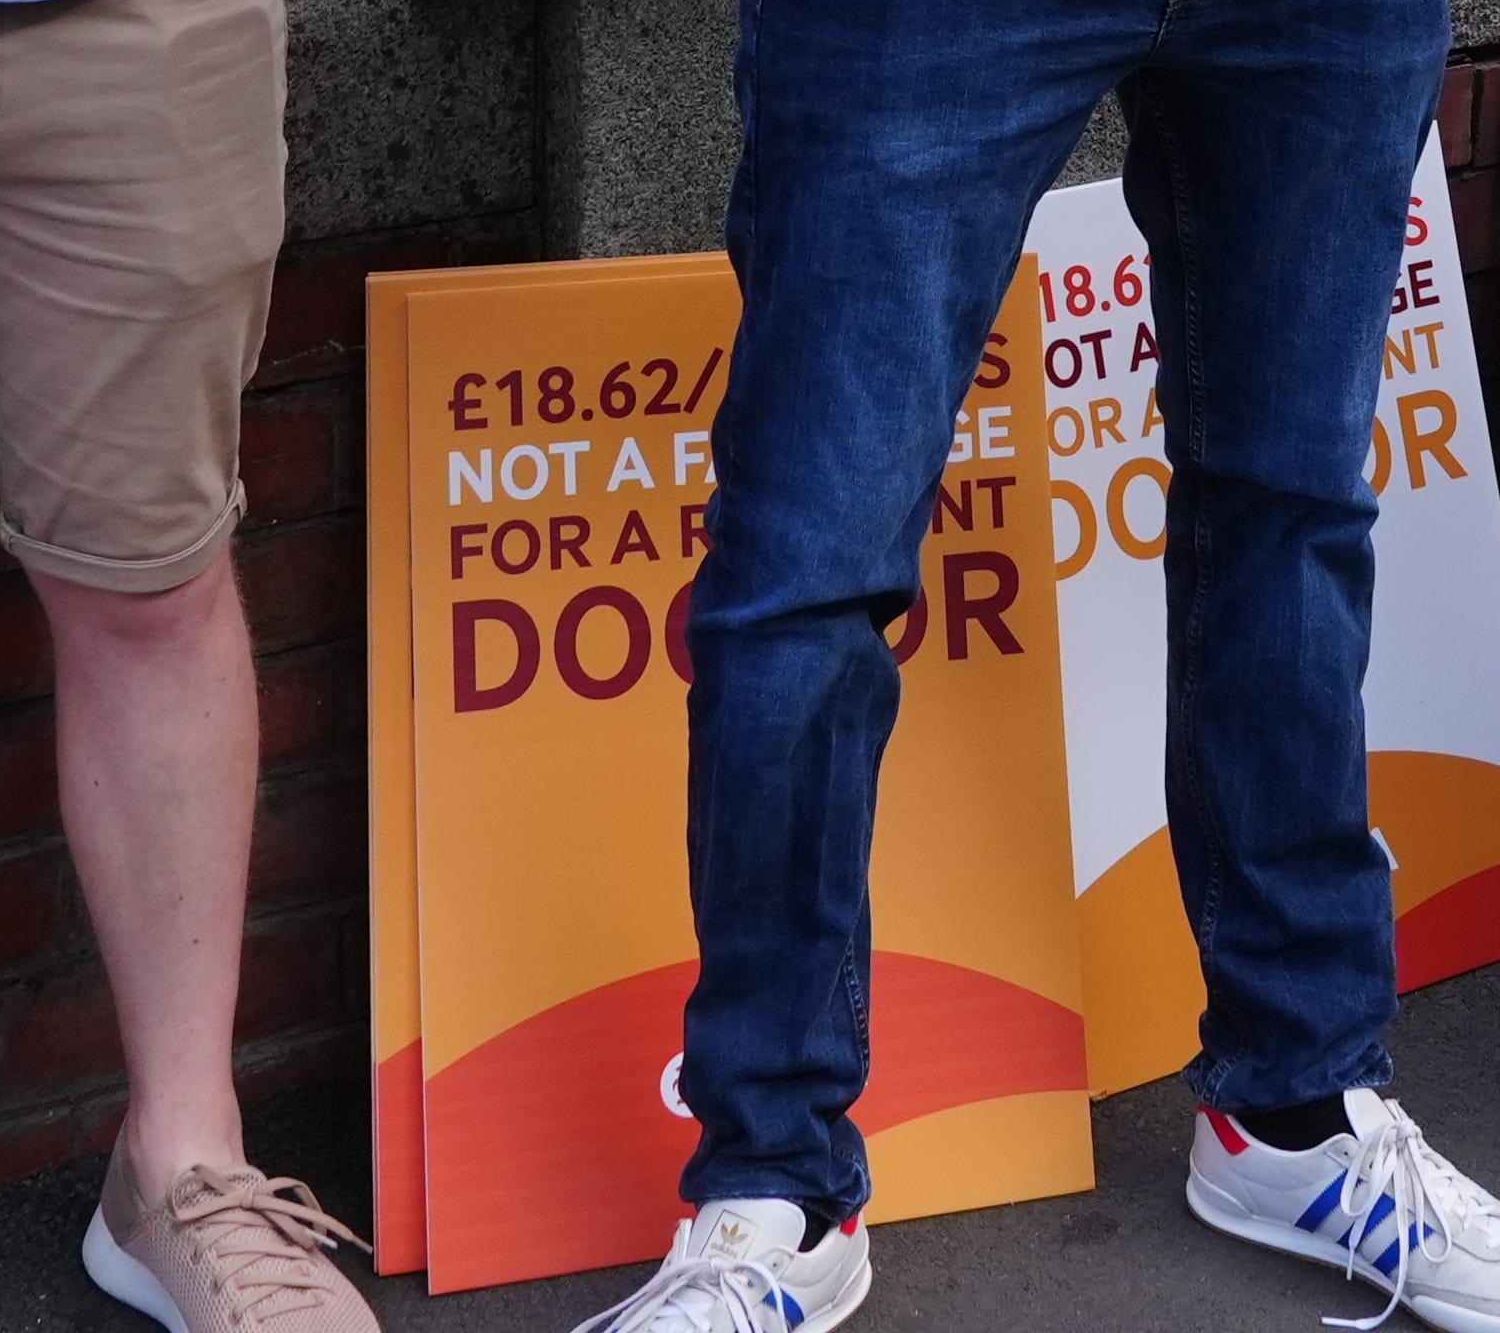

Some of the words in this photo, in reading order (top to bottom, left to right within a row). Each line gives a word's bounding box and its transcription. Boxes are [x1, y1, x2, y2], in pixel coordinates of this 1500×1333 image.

[1045, 328, 1113, 389] OT
[1046, 397, 1128, 457] OR
[447, 440, 591, 507] NOT
[606, 436, 657, 492] A
[450, 514, 593, 580] FOR
[610, 509, 661, 566] A
